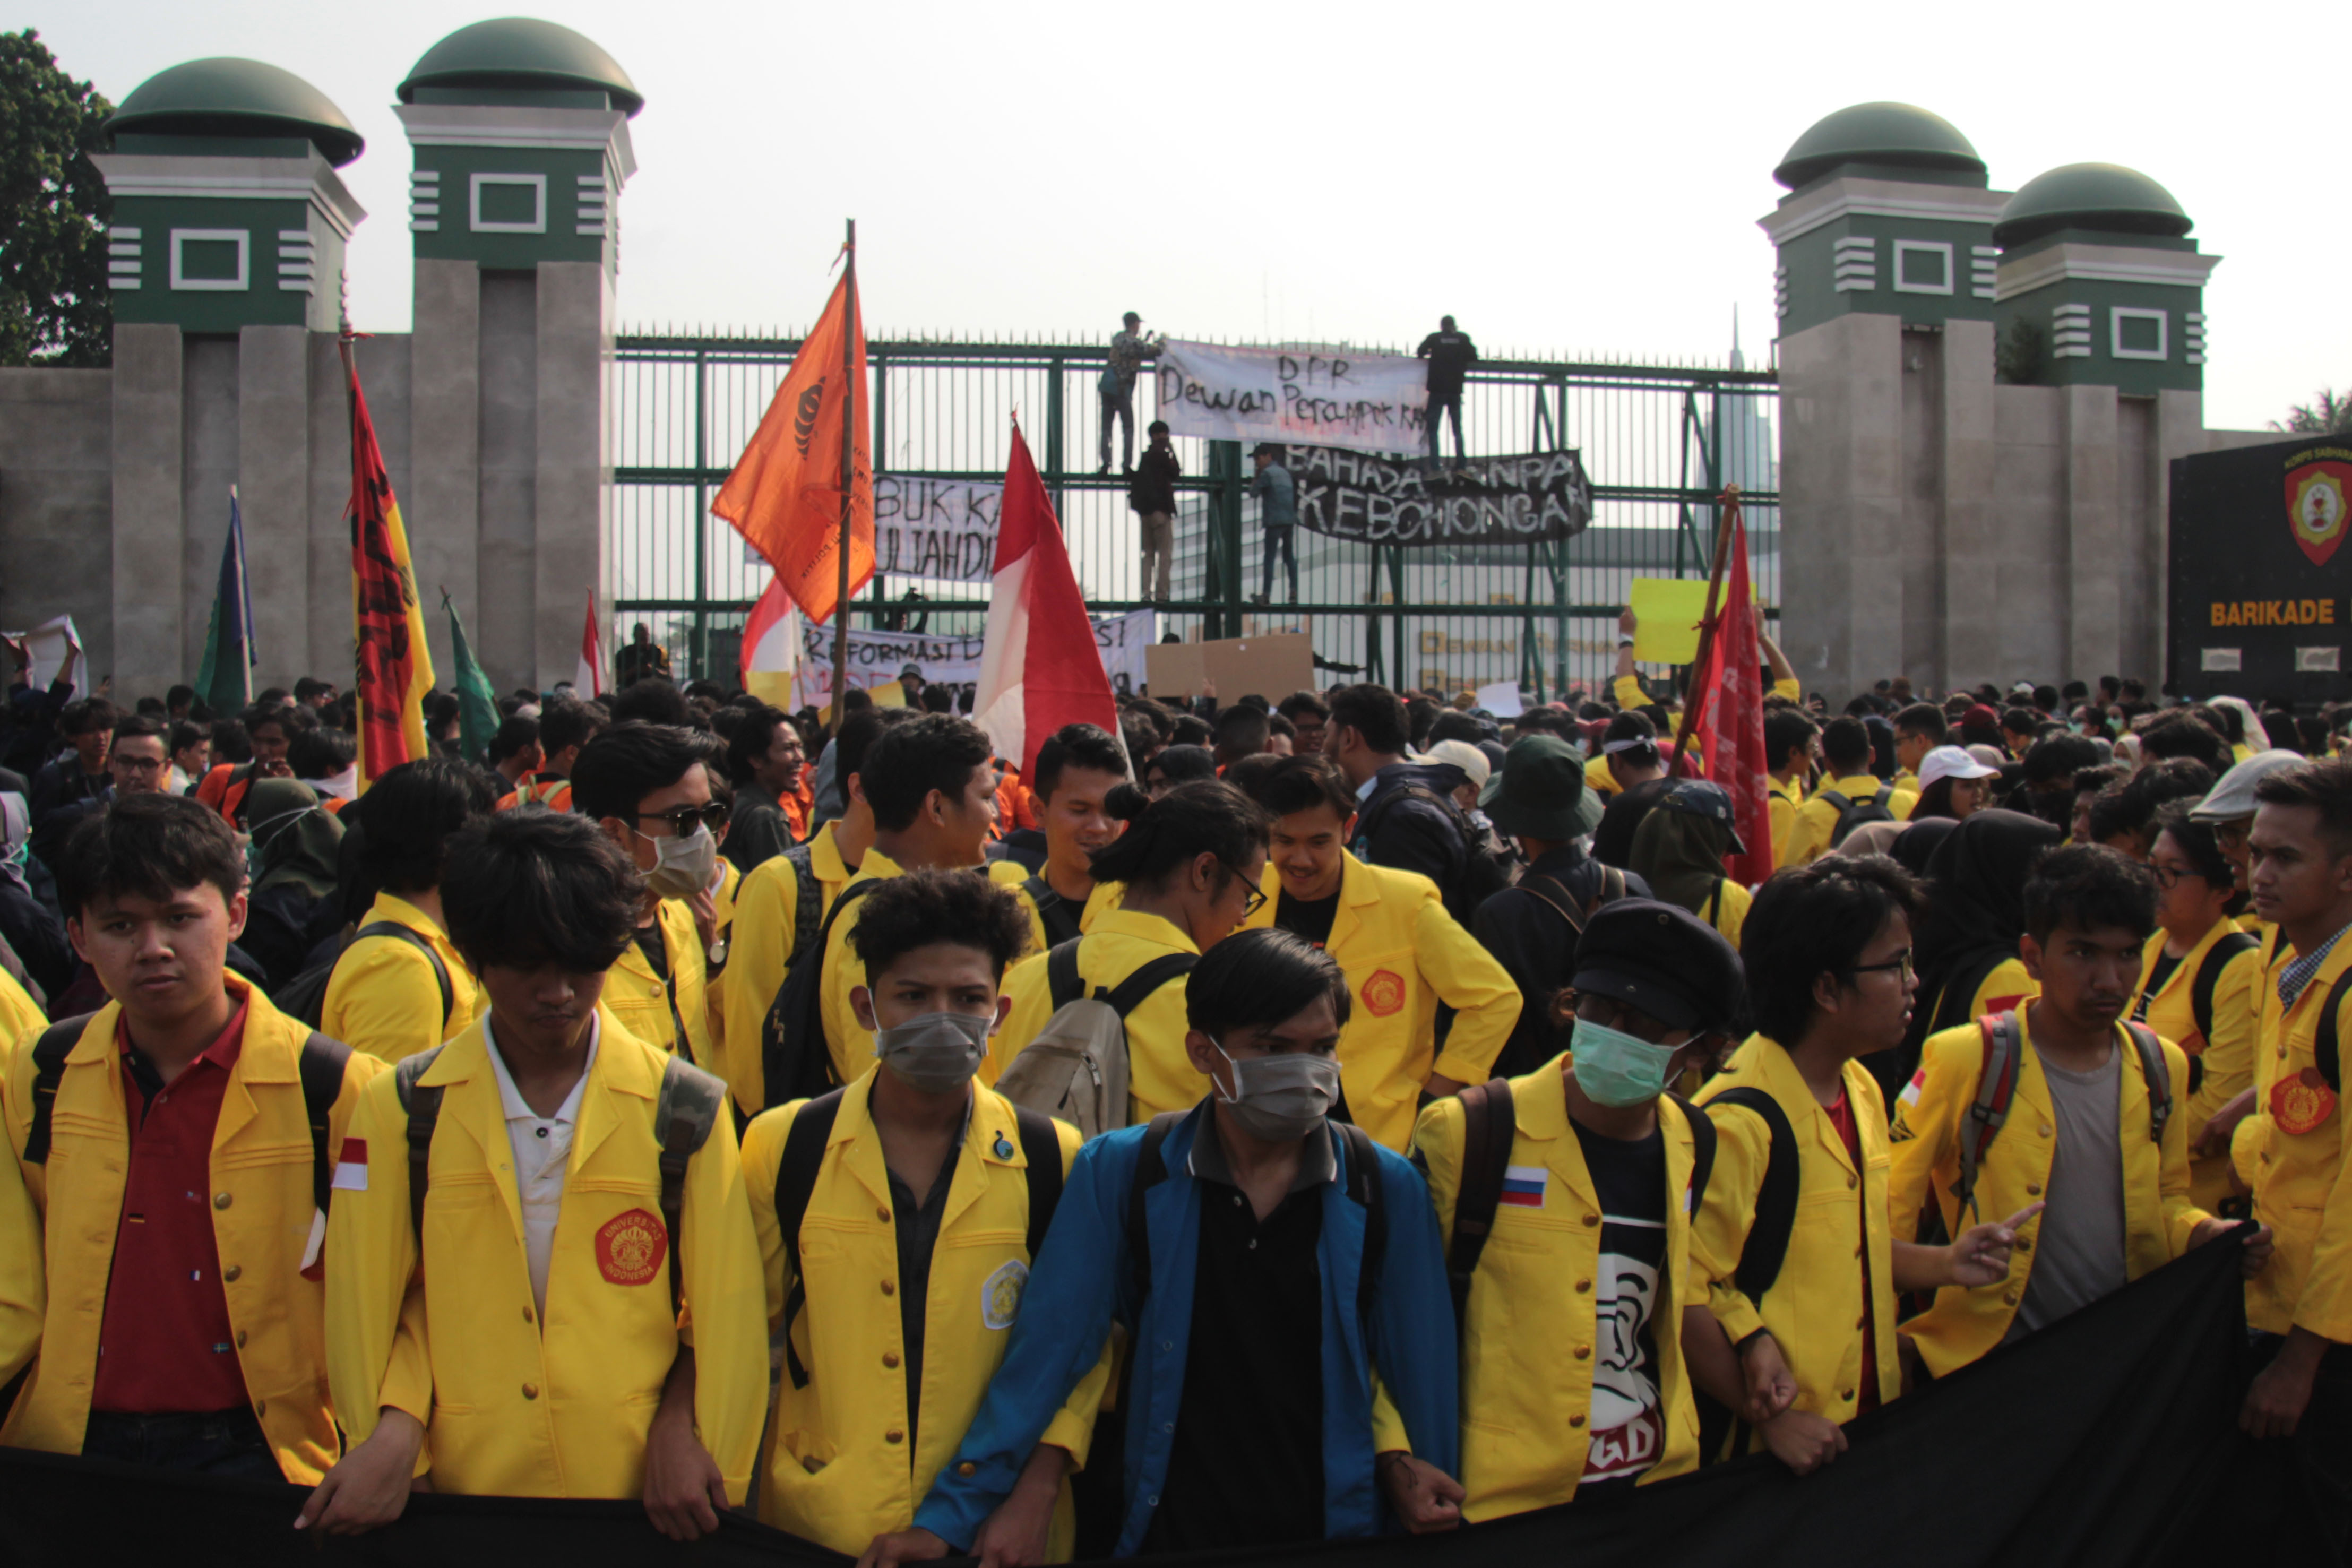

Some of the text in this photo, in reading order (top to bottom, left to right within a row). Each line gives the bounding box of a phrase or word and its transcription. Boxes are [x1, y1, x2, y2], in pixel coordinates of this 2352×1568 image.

[1278, 355, 1360, 390] DPR
[1161, 364, 1277, 413] Dewan
[2211, 599, 2335, 626] BARIKADE
[604, 1216, 662, 1240] UNIVERSITAS
[604, 1262, 655, 1280] INDONESIA
[1589, 1417, 1655, 1470] GD
